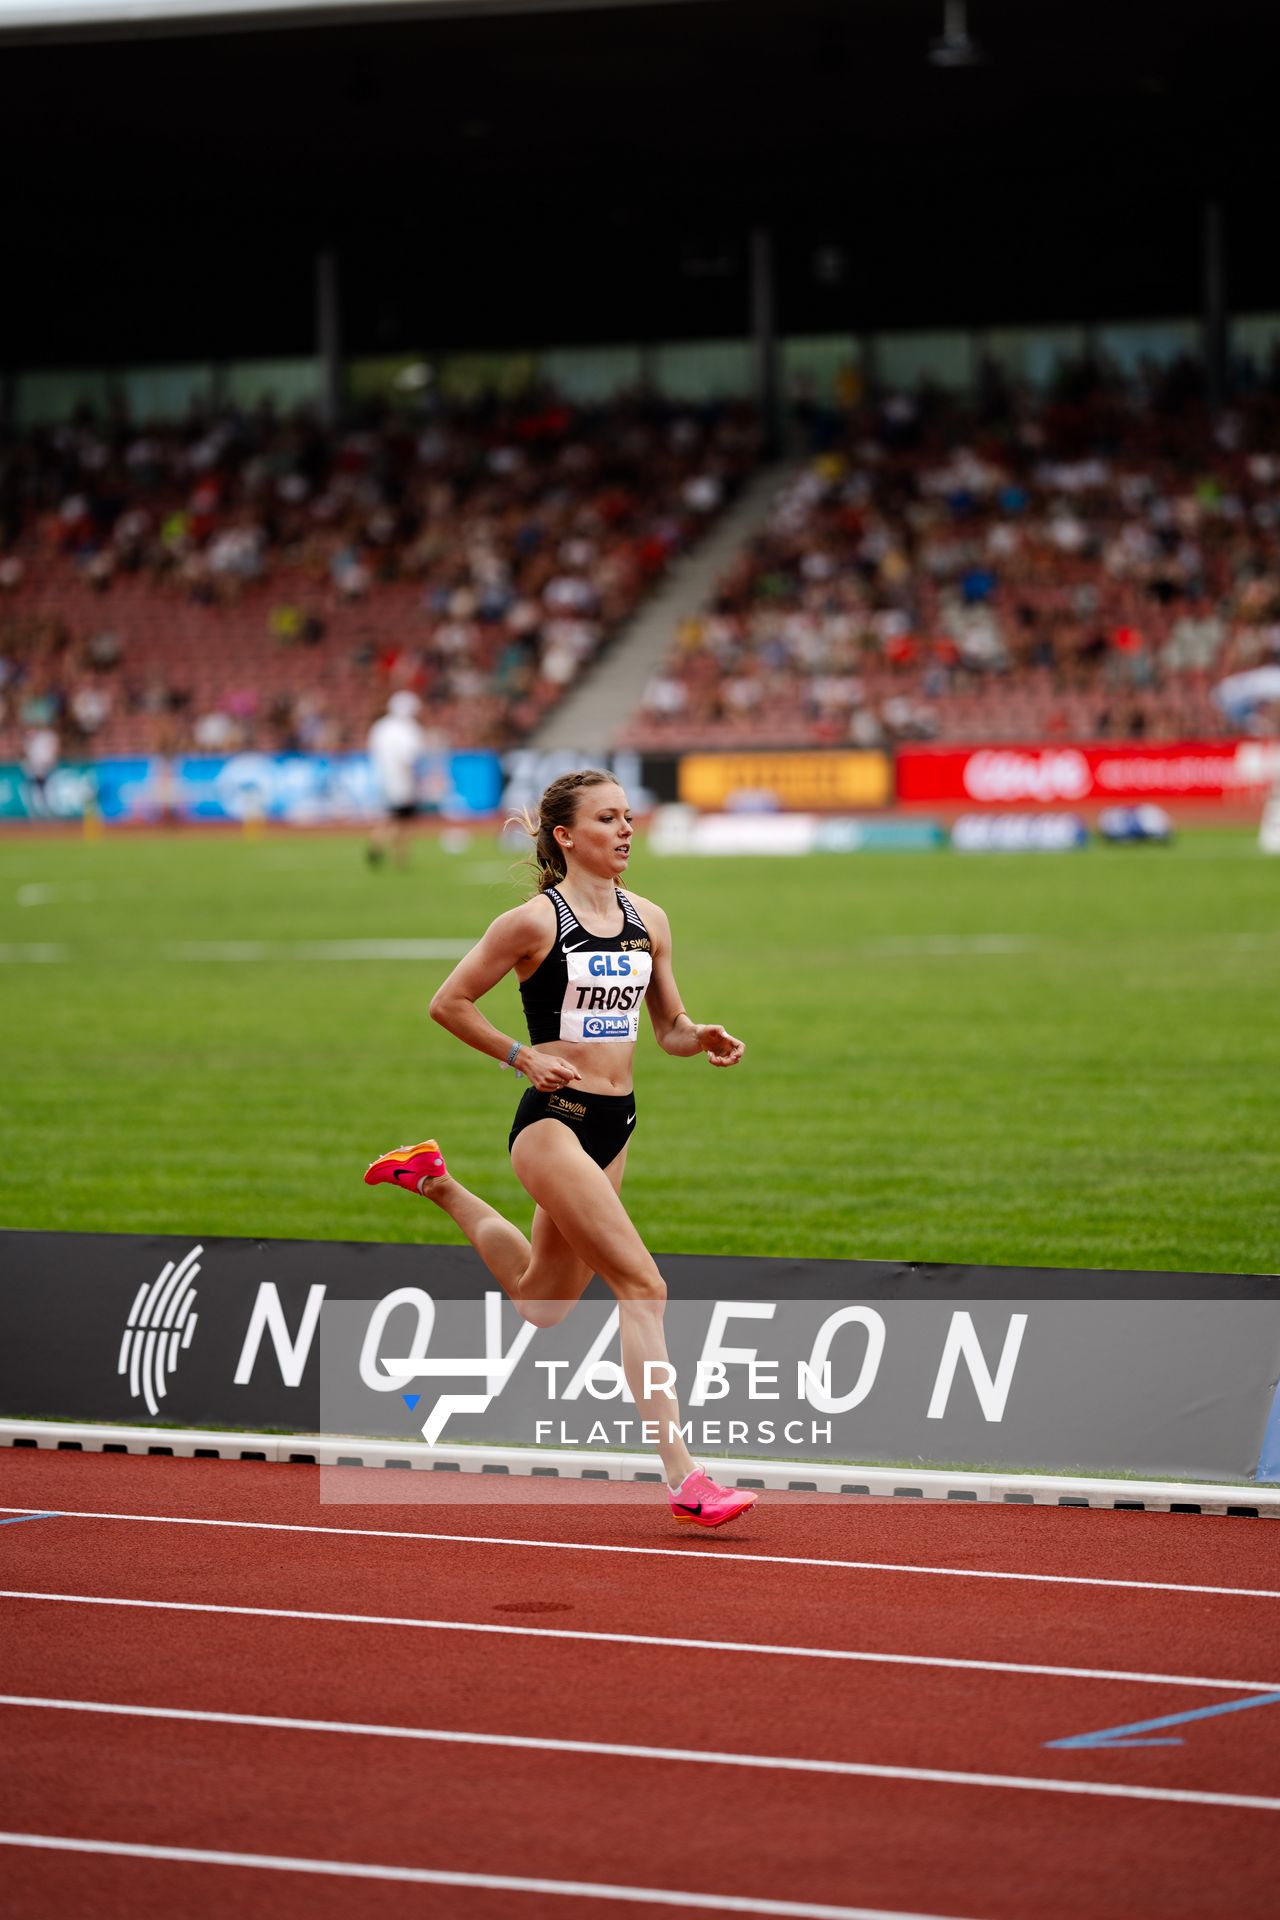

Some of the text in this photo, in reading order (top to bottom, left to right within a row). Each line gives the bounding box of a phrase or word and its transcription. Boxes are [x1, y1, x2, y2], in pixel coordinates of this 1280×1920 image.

[576, 985, 644, 1011] TROST
[605, 1019, 629, 1030] PLAN
[233, 1281, 1029, 1423] NOVAFON
